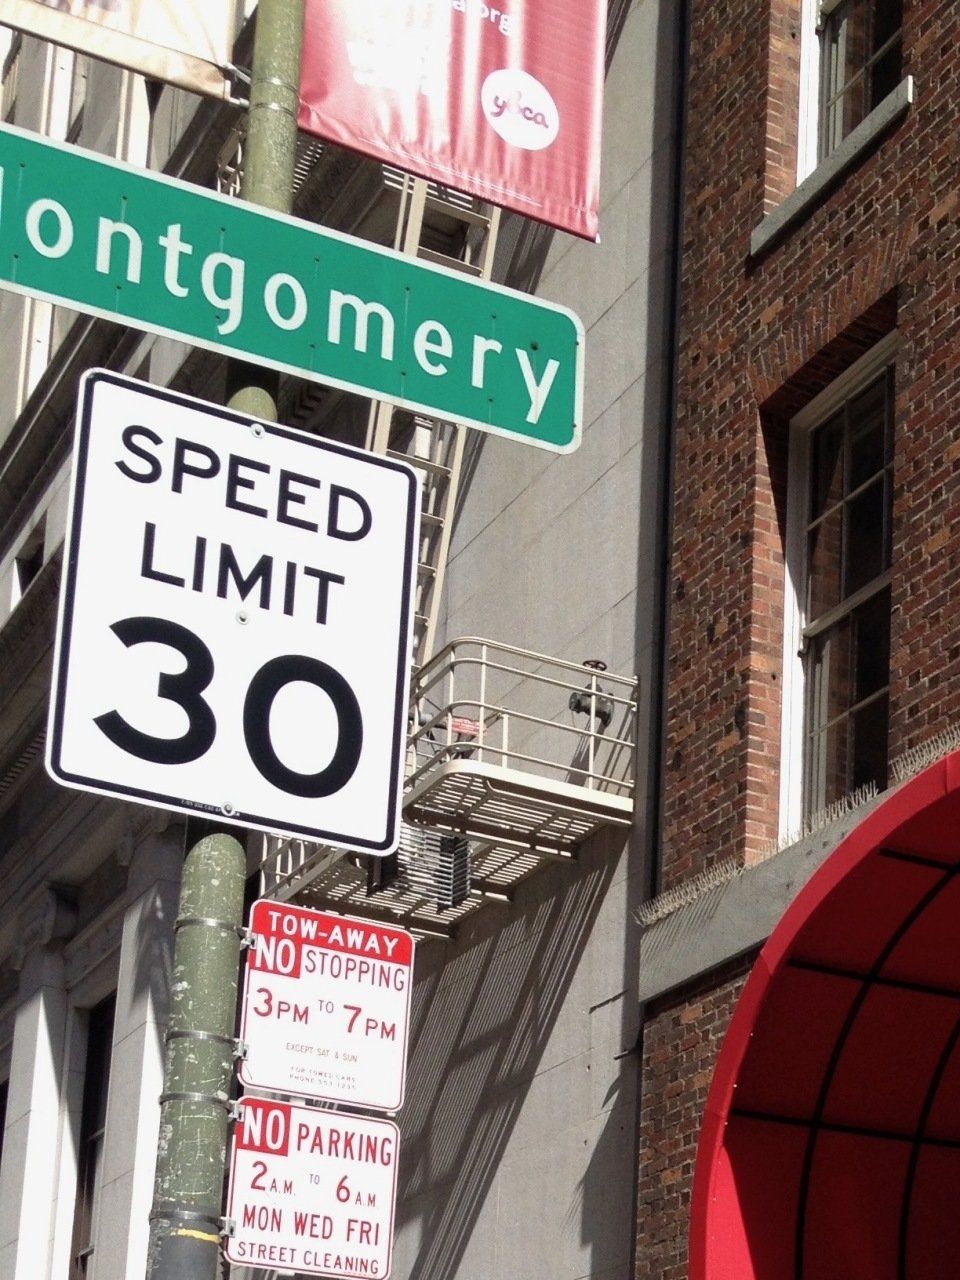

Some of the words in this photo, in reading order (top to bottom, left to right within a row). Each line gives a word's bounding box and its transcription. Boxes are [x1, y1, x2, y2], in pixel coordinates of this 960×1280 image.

[0, 167, 559, 424] ontgomery
[115, 424, 372, 542] SPEED
[141, 522, 345, 625] LIMIT
[92, 616, 363, 798] 30
[268, 911, 399, 957] TOW-AWAY
[255, 933, 296, 975] NO
[305, 949, 405, 992] STOPPING
[318, 1000, 335, 1014] TO
[286, 1042, 314, 1055] EXCEPT
[318, 1047, 330, 1057] SAT
[343, 1053, 358, 1063] SUN
[243, 1104, 285, 1151] NO
[297, 1123, 392, 1166] PARKING
[309, 1173, 321, 1185] TO
[243, 1204, 282, 1234] MON
[294, 1211, 333, 1240] WED
[346, 1219, 379, 1246] FRI
[238, 1241, 297, 1264] STREET
[304, 1249, 379, 1275] CLEANING
